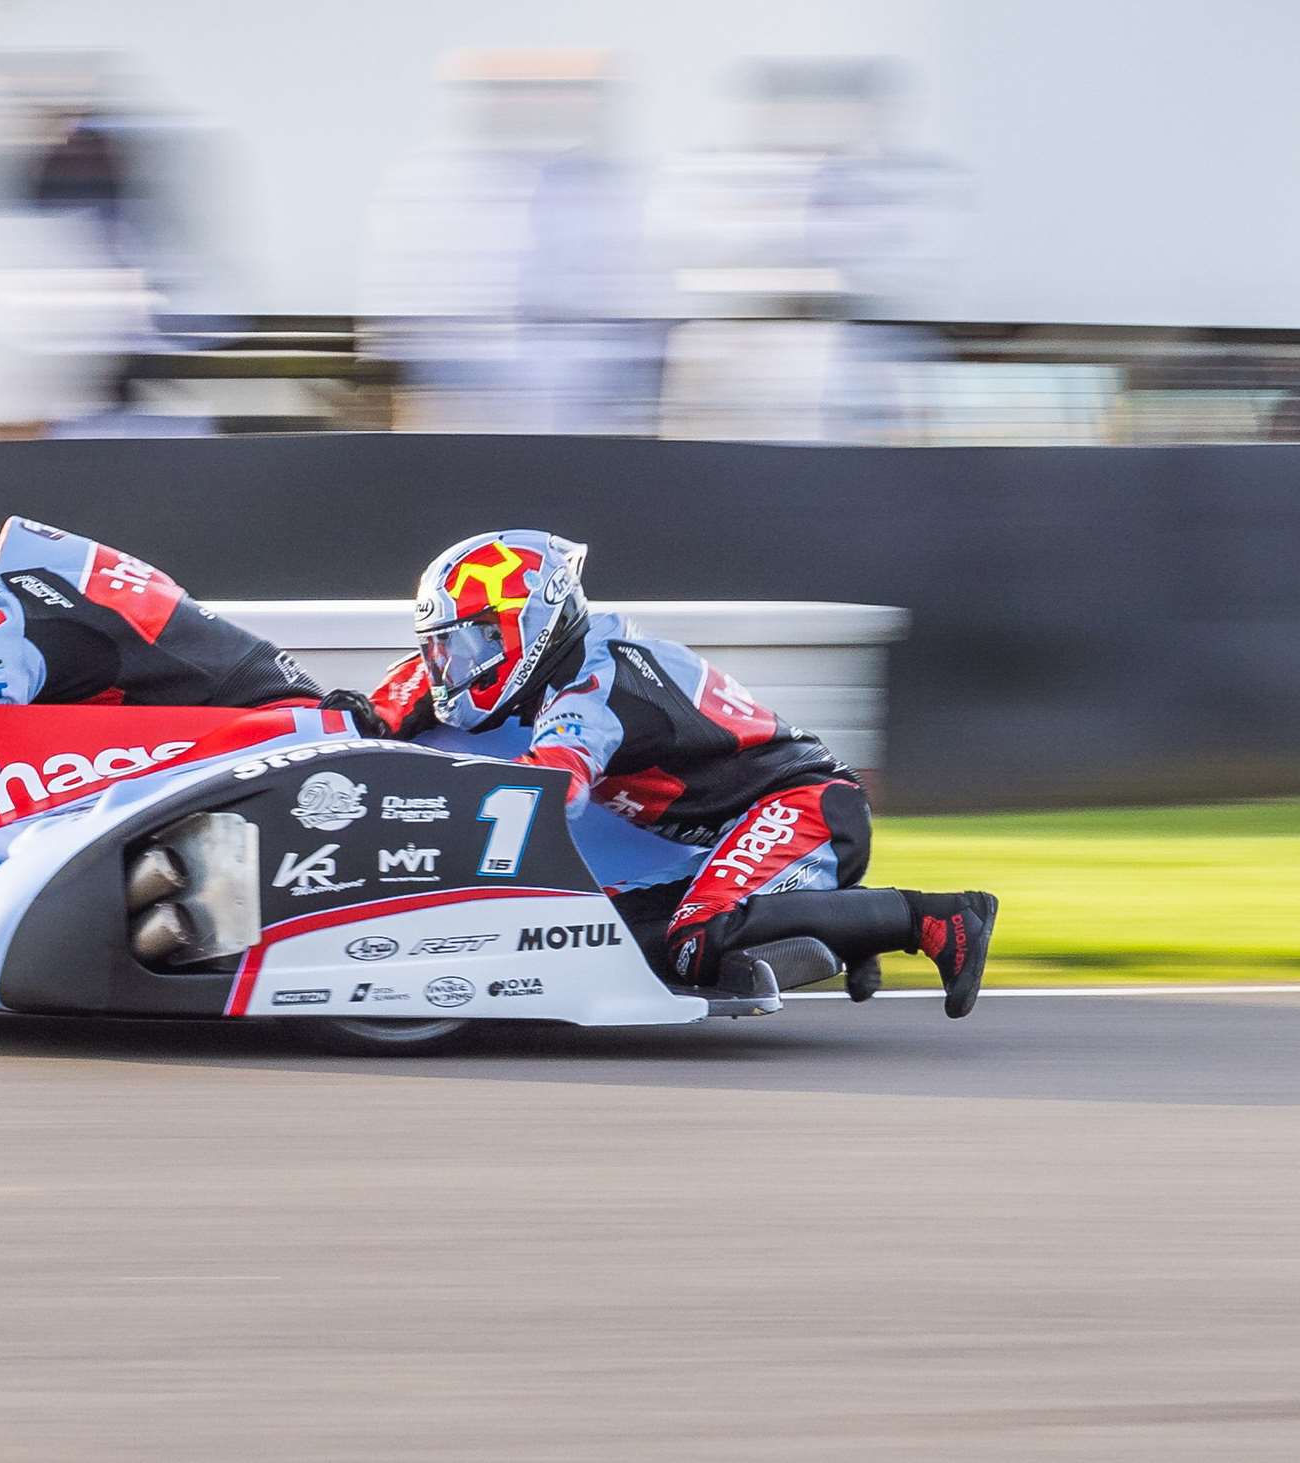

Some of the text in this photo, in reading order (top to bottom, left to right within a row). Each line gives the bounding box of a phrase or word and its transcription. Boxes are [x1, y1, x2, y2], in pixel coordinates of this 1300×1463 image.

[475, 784, 544, 878] 1
[408, 934, 501, 956] RST
[516, 923, 622, 952] MOTUL
